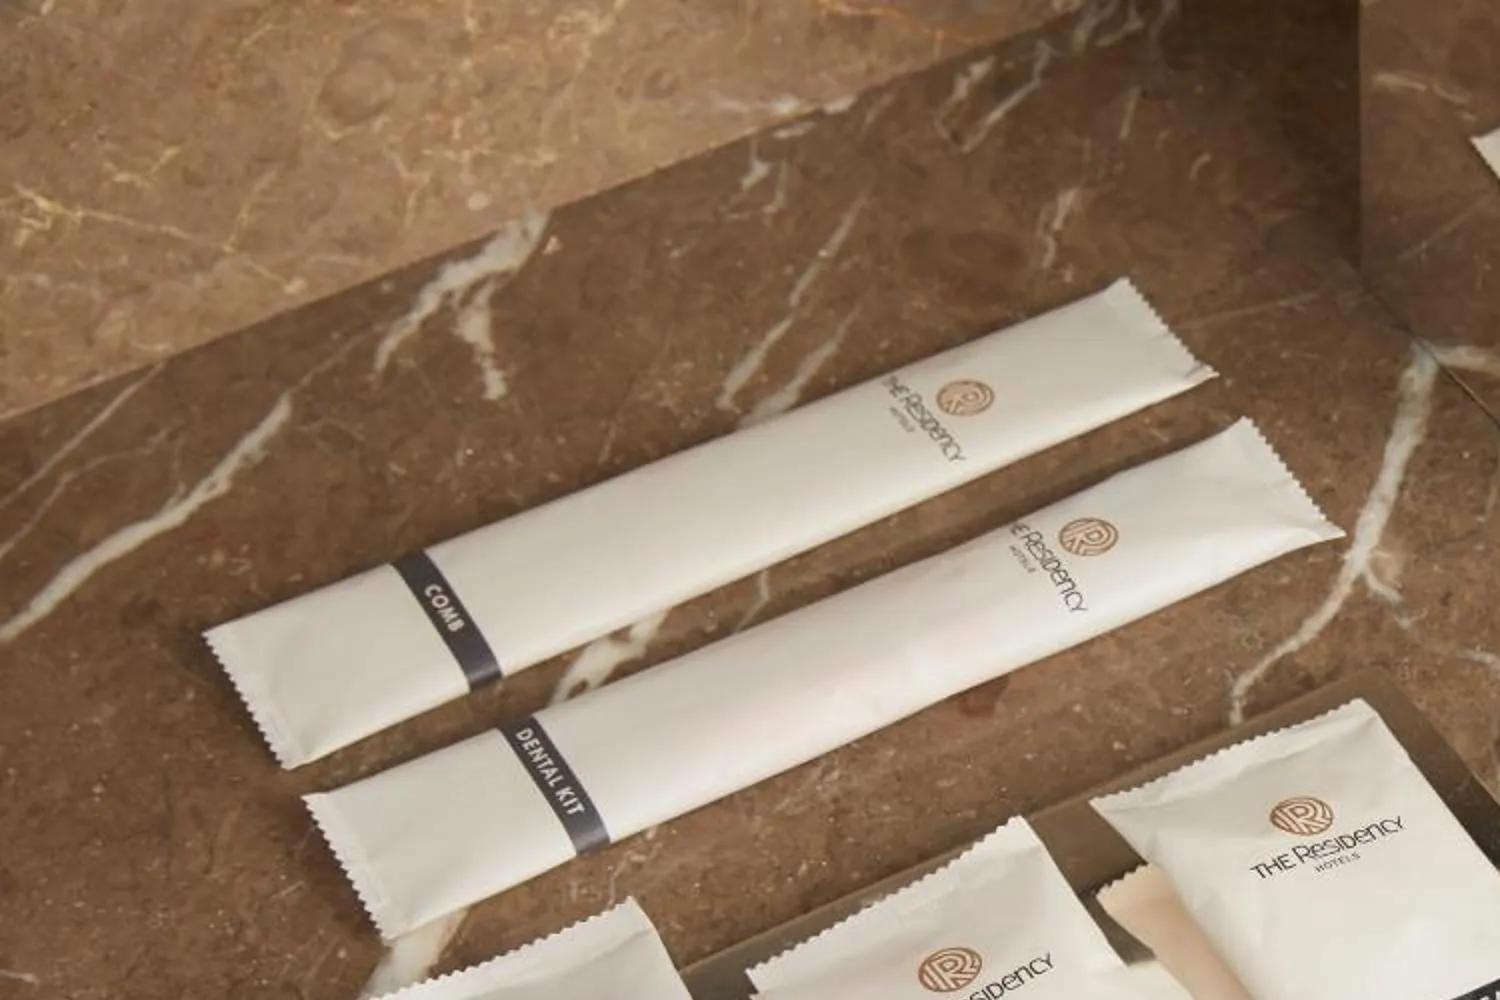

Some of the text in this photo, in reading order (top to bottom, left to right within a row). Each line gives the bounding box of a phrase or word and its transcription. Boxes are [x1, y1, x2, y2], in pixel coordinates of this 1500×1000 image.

[424, 584, 465, 632] COMB
[515, 728, 586, 815] DENTAL KIT
[1250, 853, 1296, 879] THE
[1315, 852, 1361, 873] HOTELS
